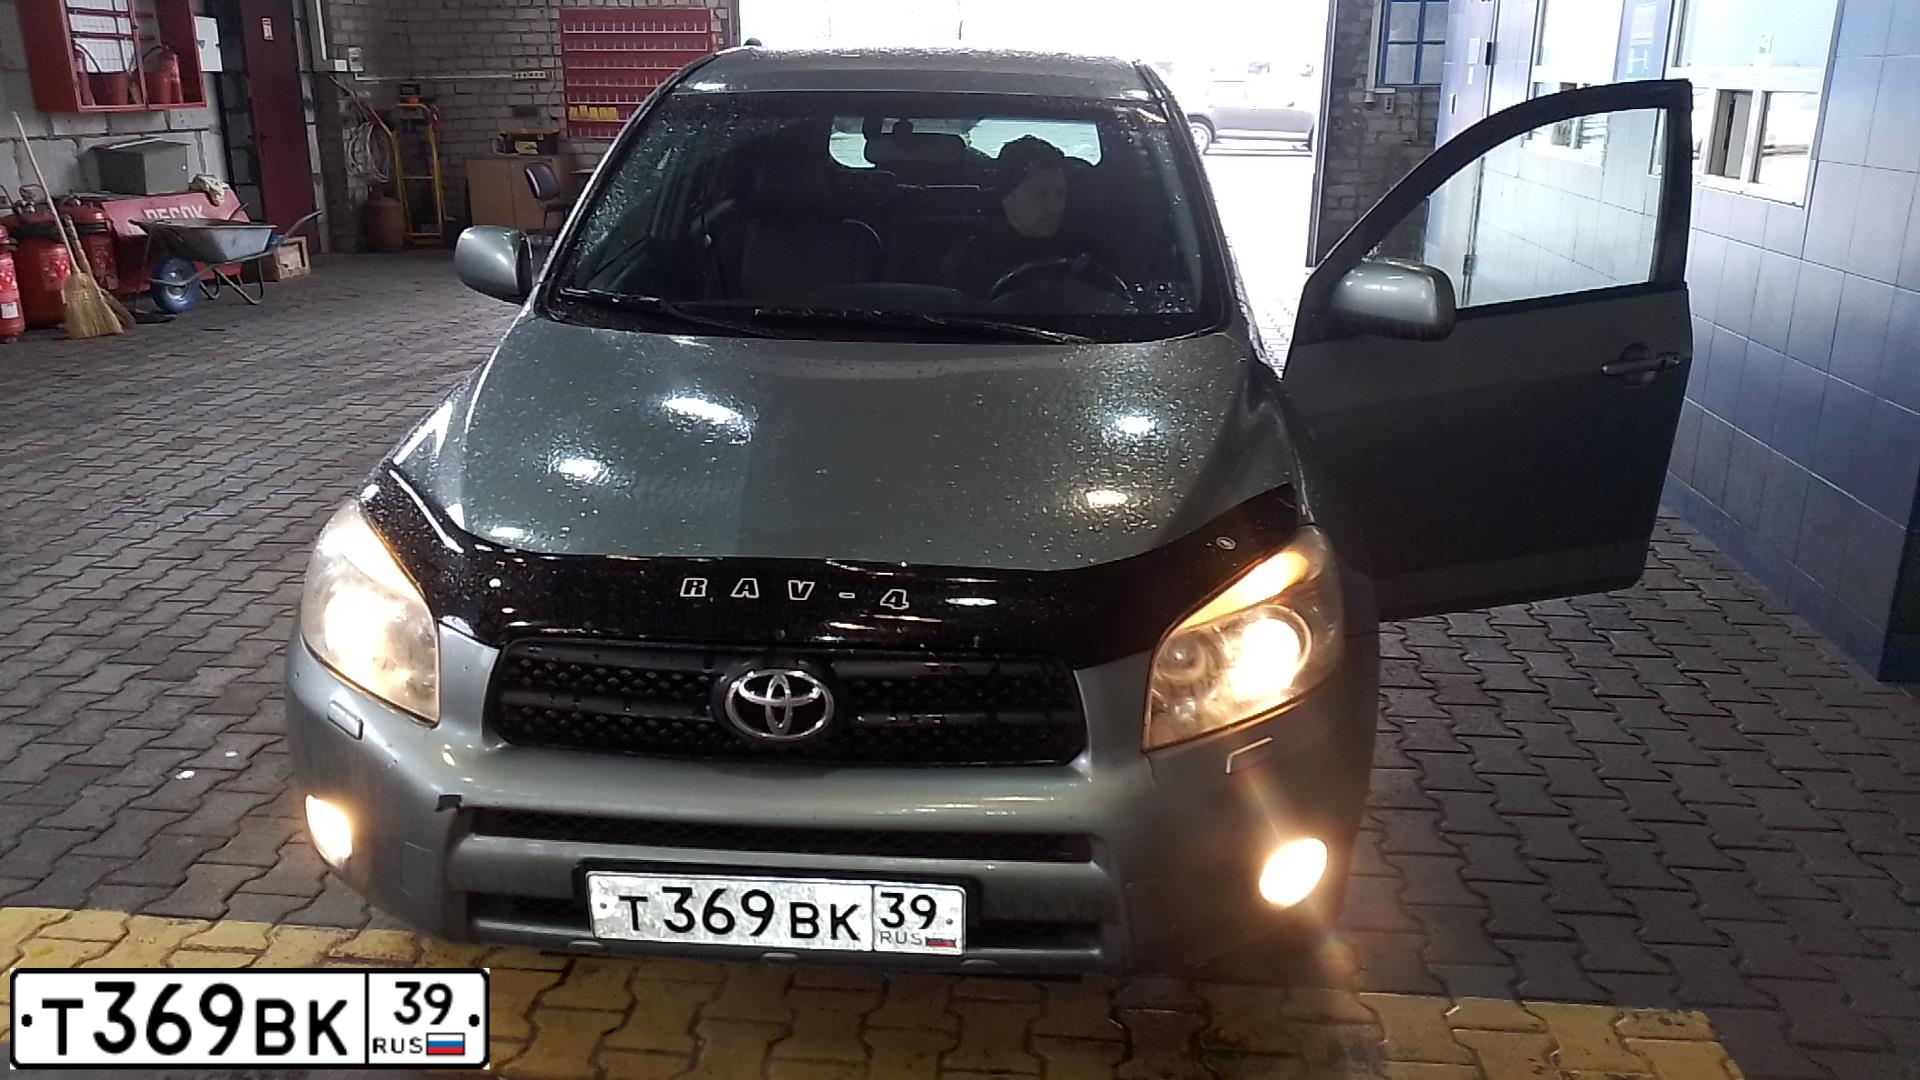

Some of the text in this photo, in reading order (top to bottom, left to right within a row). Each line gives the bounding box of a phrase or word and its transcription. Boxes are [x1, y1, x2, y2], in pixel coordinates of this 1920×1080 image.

[680, 577, 909, 609] RAV-4
[880, 891, 937, 930] 39
[879, 931, 923, 946] RUS
